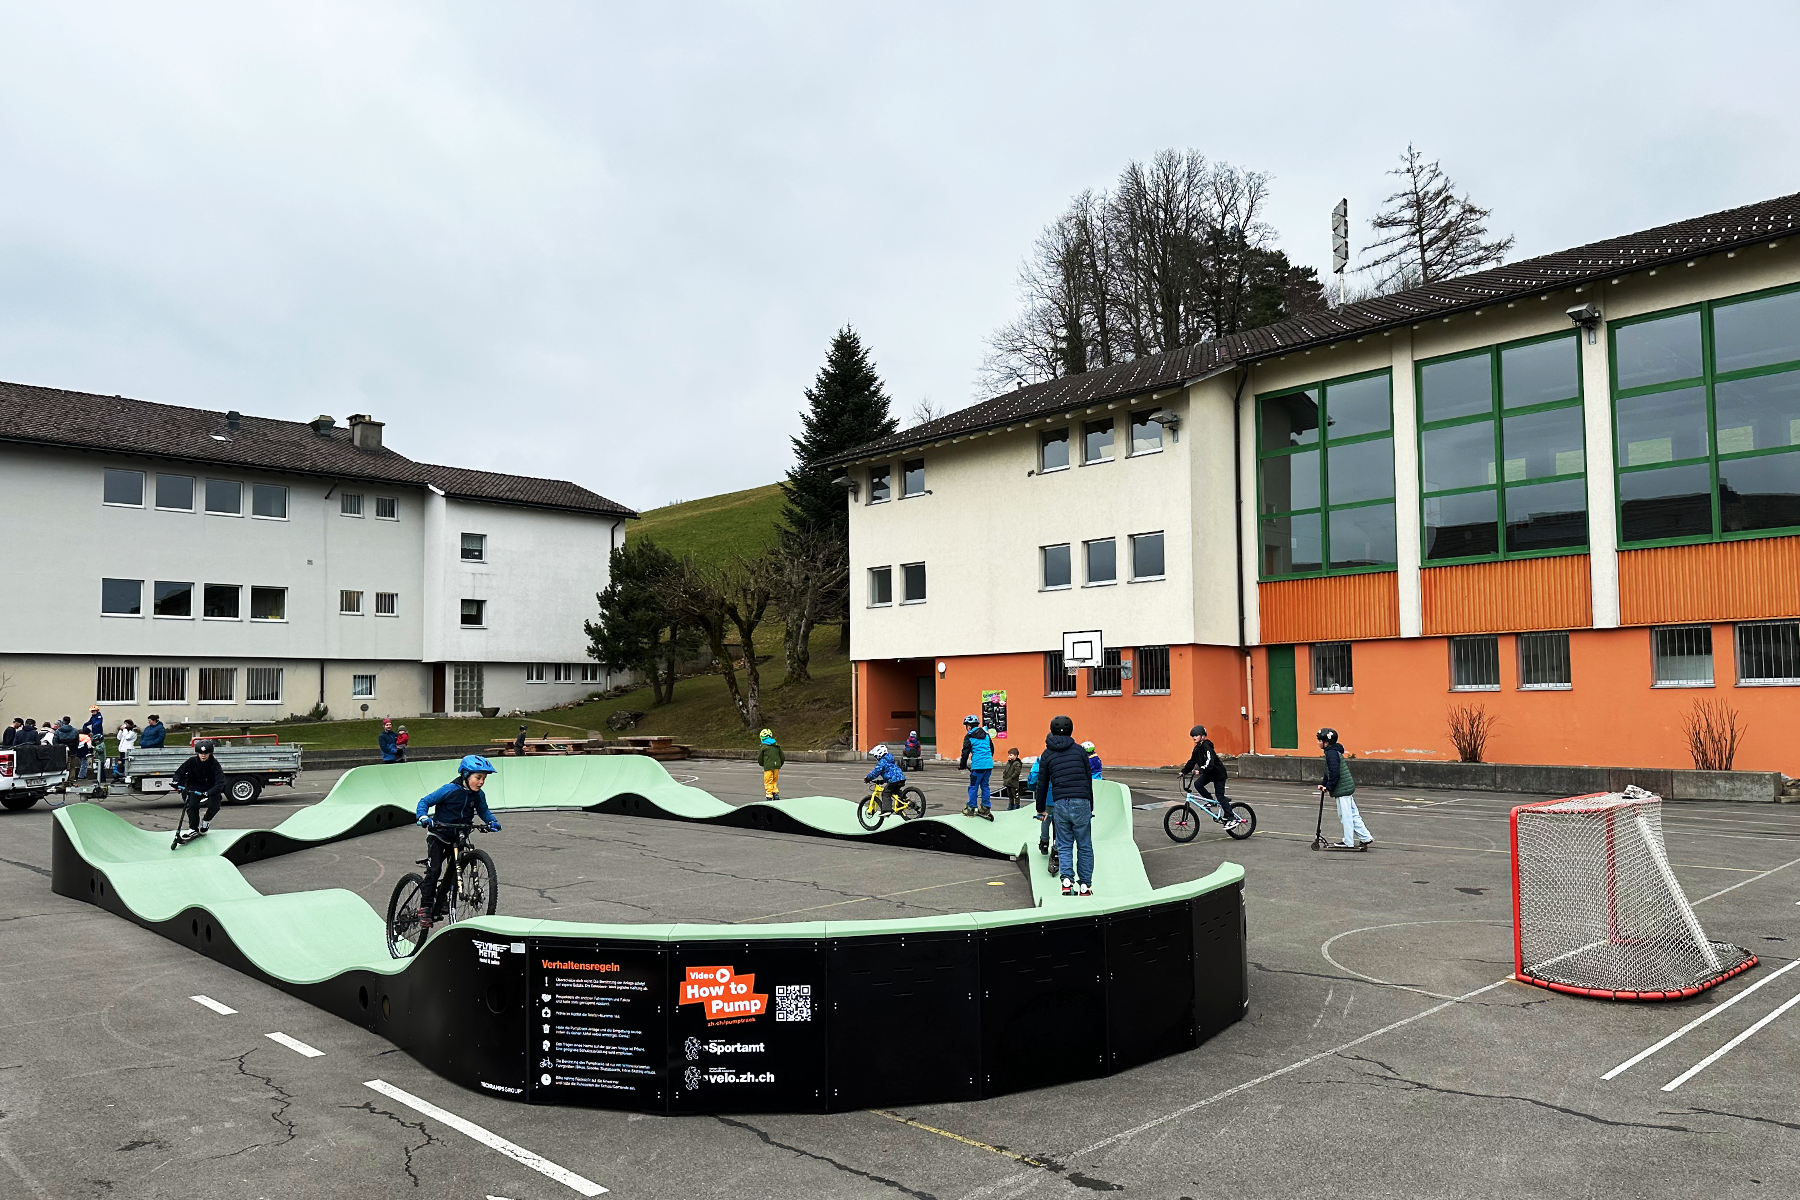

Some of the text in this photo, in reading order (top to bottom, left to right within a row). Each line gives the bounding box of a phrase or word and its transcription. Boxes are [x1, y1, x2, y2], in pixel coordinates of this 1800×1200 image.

[479, 949, 500, 959] METAL
[541, 959, 620, 973] Verhaltensregeln
[690, 971, 715, 980] Video
[686, 981, 747, 999] How to
[711, 999, 761, 1013] Pump
[708, 1042, 765, 1056] Sportamt
[709, 1071, 775, 1083] velo.zh.ch
